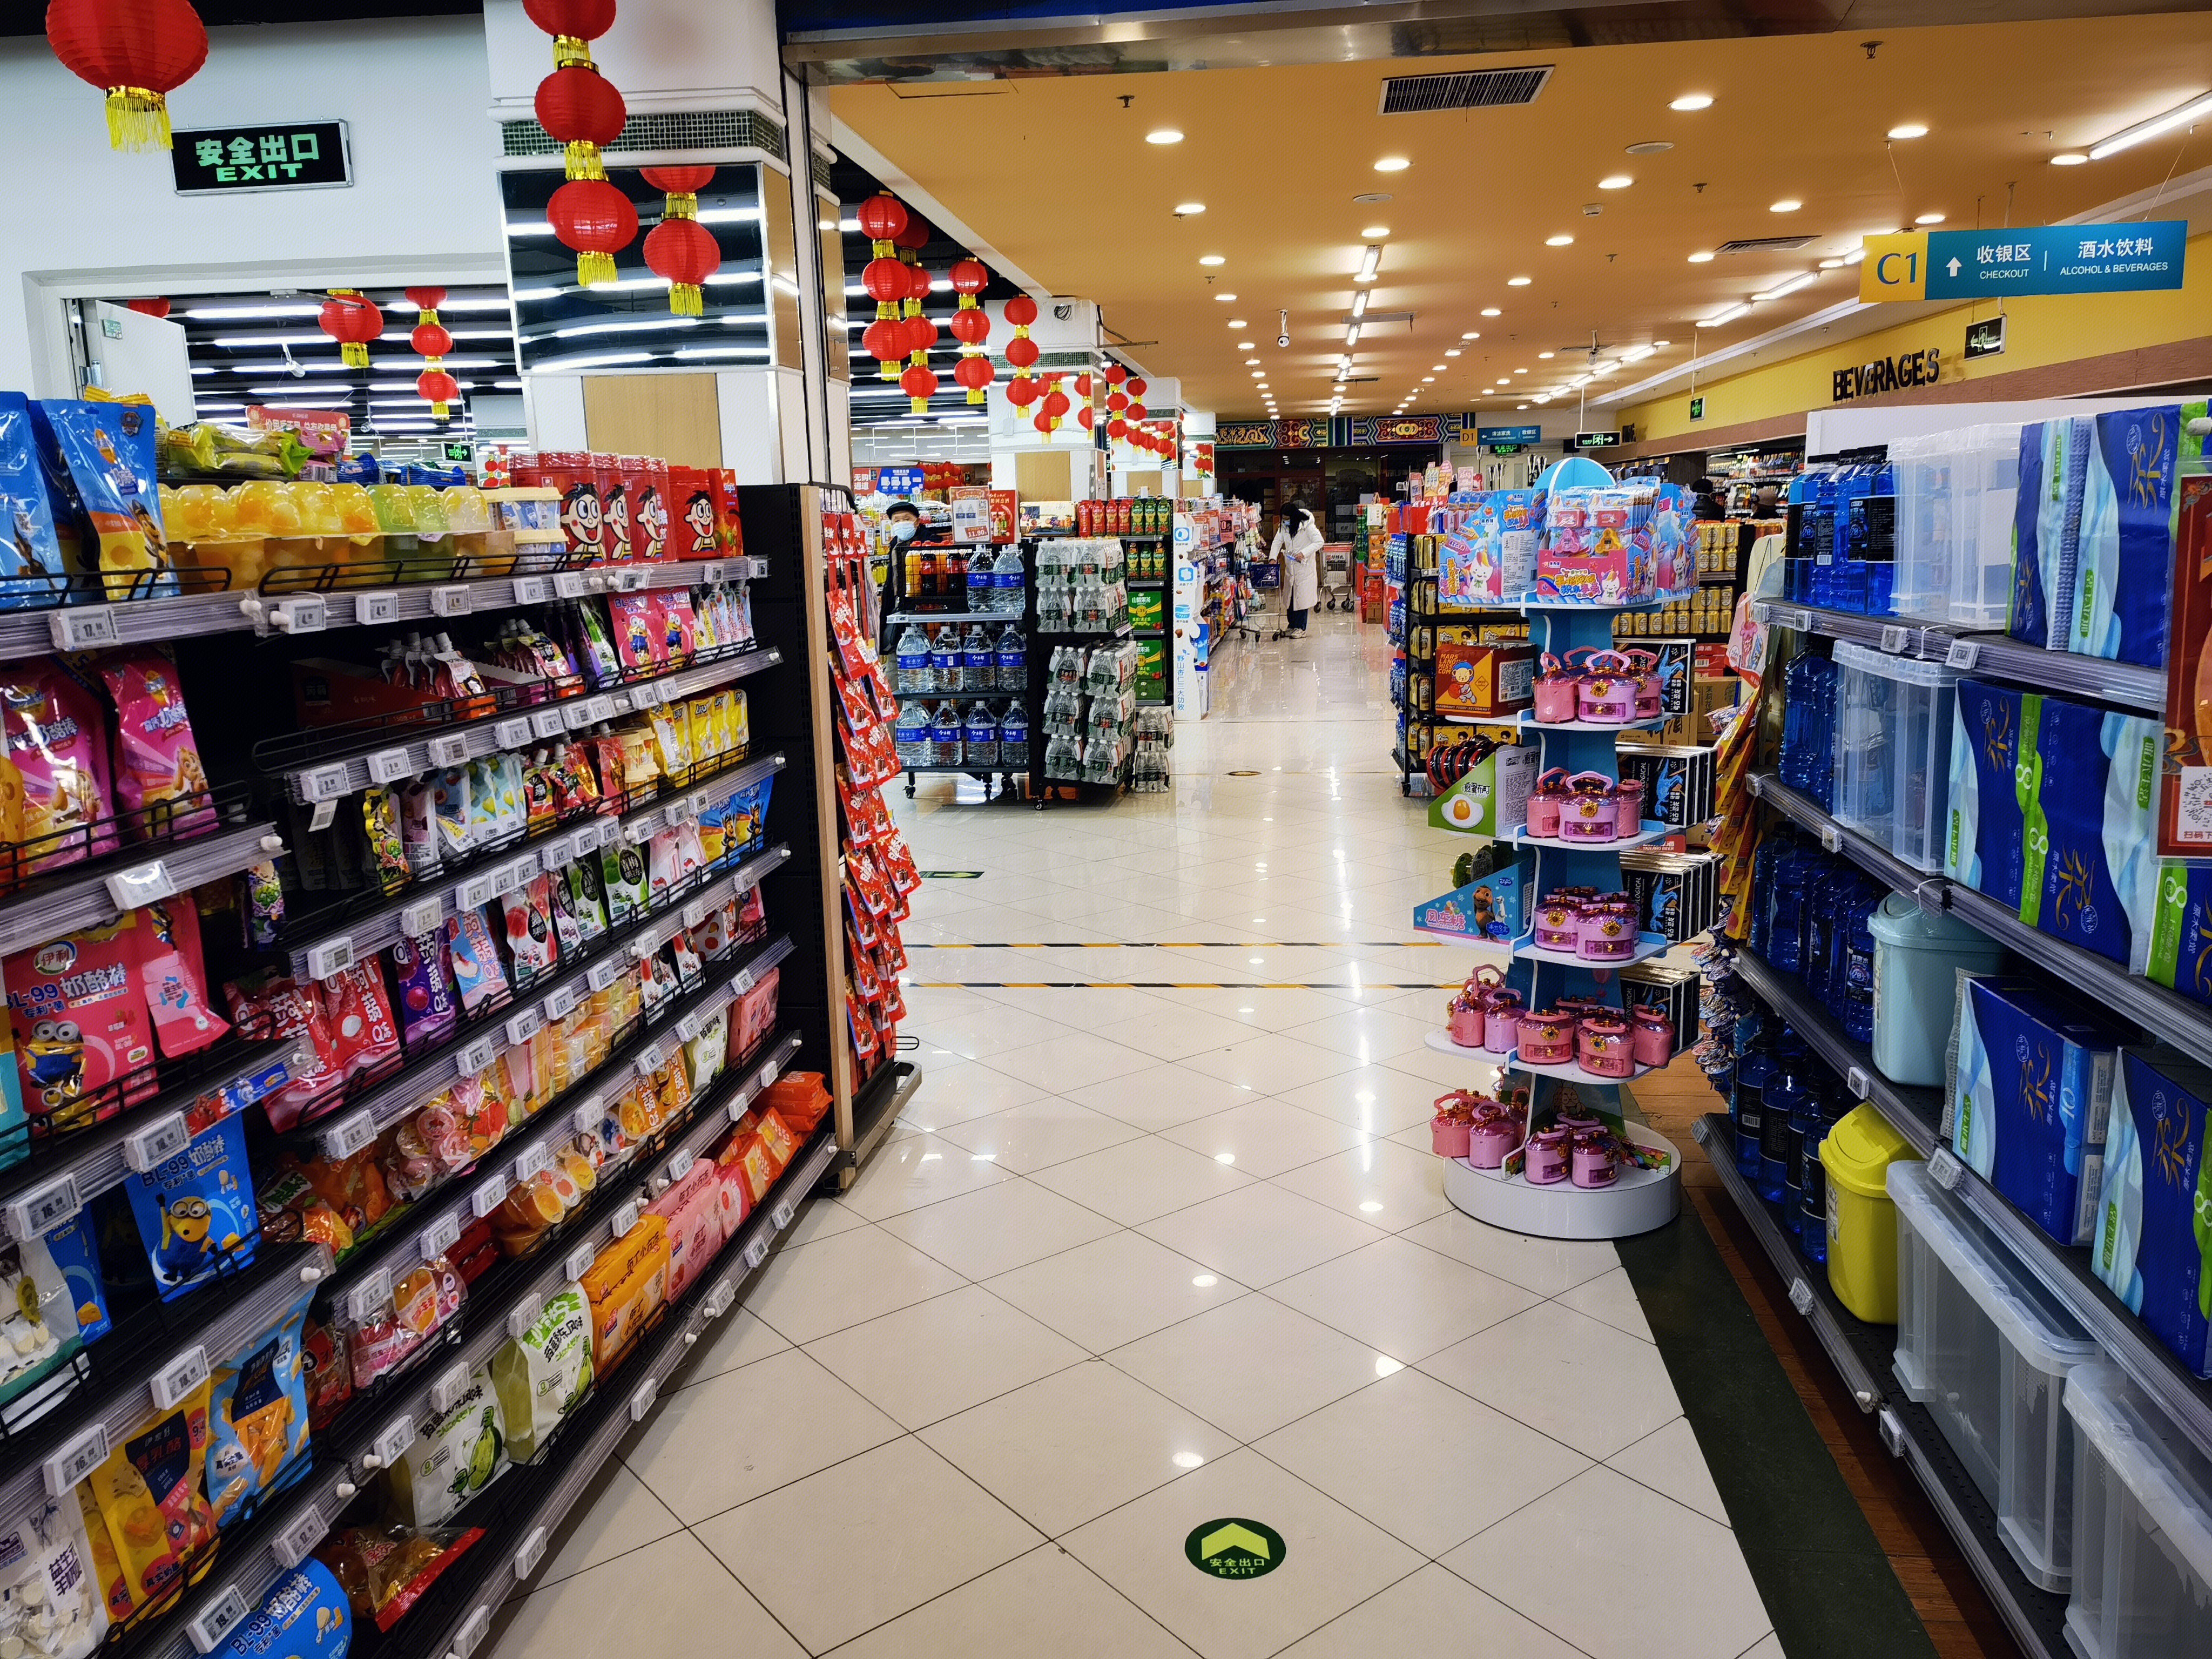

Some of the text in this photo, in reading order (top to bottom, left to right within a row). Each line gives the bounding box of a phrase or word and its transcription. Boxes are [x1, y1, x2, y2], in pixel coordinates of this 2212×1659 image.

[195, 133, 319, 166] 安全出口
[216, 163, 302, 181] EXIT
[1977, 244, 2031, 264] 收银区
[2078, 238, 2154, 259] 酒水饮料
[1877, 252, 1917, 285] C1
[1980, 269, 2029, 280] CHECKOUT
[2060, 262, 2168, 275] ALCOHOL & BEVERAGES
[1833, 348, 1940, 401] BEVERAGES
[1462, 433, 1474, 442] D1
[1177, 655, 1185, 711] 野山杏仁三大功效
[1426, 908, 1466, 930] 风车糖
[41, 948, 70, 967] 伊利
[59, 961, 127, 999] 奶酪棒
[141, 1157, 190, 1187] BL-99
[1209, 1557, 1265, 1567] 安全出口
[231, 1613, 273, 1656] BL-99
